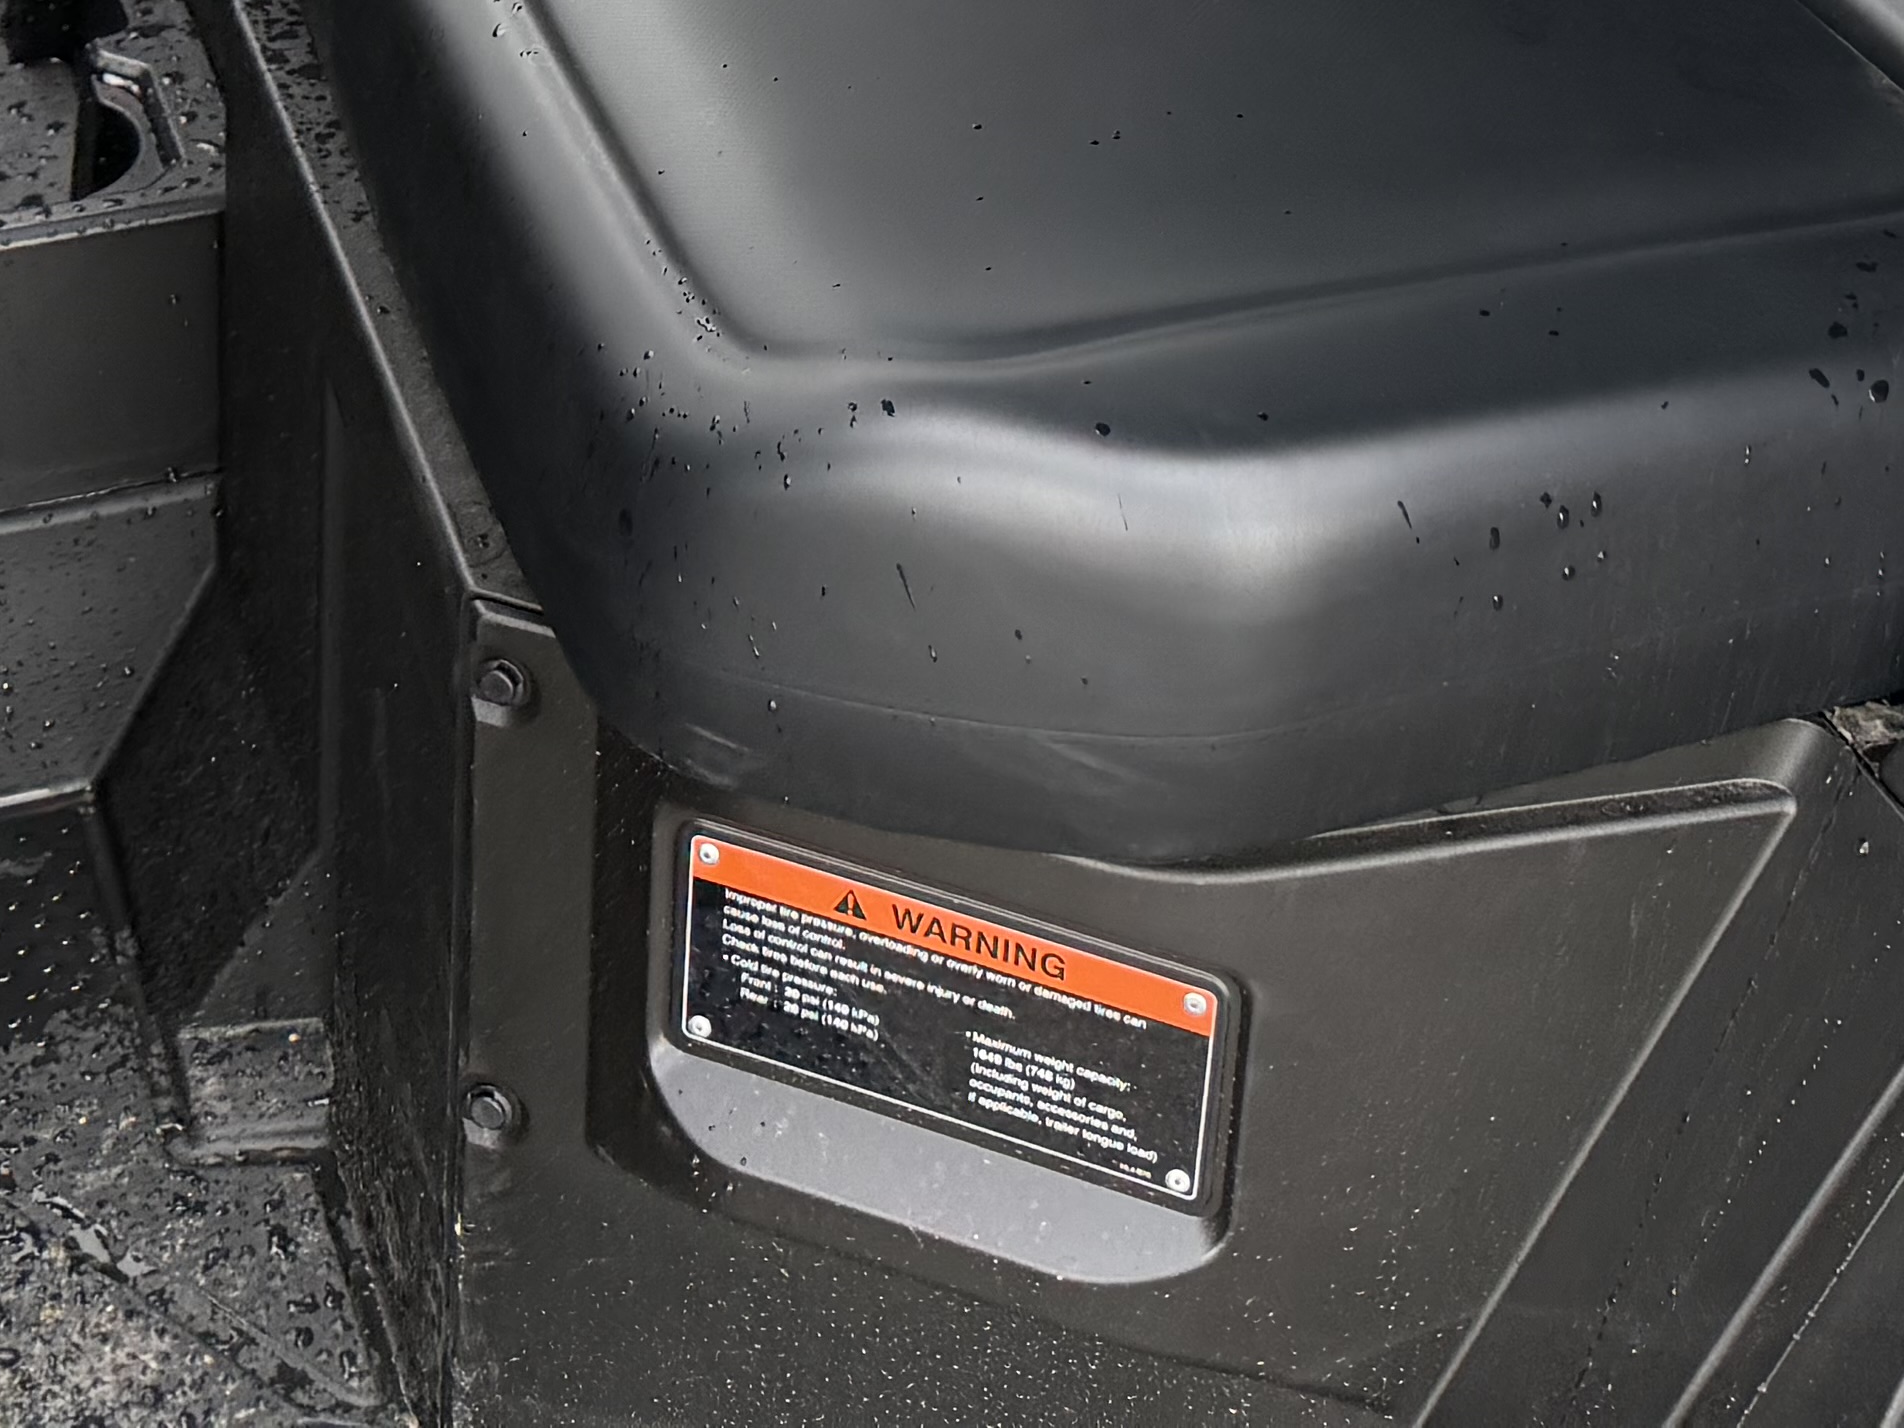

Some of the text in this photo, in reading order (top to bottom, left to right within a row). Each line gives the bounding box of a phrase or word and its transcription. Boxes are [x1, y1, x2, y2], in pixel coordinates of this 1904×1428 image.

[723, 905, 846, 951] cause loss of control.
[724, 888, 1147, 1030] Improper tire pressure, overloading or overly worn or damaged tires can
[891, 903, 1066, 981] WARNING
[721, 933, 888, 995] Check tires before each use.
[722, 918, 1016, 1020] Loss of control can result in severe injury or death.
[730, 953, 838, 997] Cold tire pressure:
[739, 986, 769, 1005] Rear
[800, 1008, 819, 1021] psi
[821, 1012, 850, 1031] (140
[850, 1021, 879, 1042] kPa)
[740, 971, 772, 992] Front
[783, 985, 801, 1000] 20
[801, 993, 821, 1006] psi
[821, 997, 850, 1017] (140
[851, 1006, 880, 1027] kPa)
[970, 1061, 1127, 1123] (Including weight of cargo,
[971, 1030, 1131, 1093] Maximum weight capacity:
[1004, 1056, 1024, 1073] lbs
[1055, 1073, 1076, 1091] kg)
[967, 1091, 1158, 1165] if applicable, trailer tongue load)
[968, 1078, 1138, 1143] occupants, accessories and,
